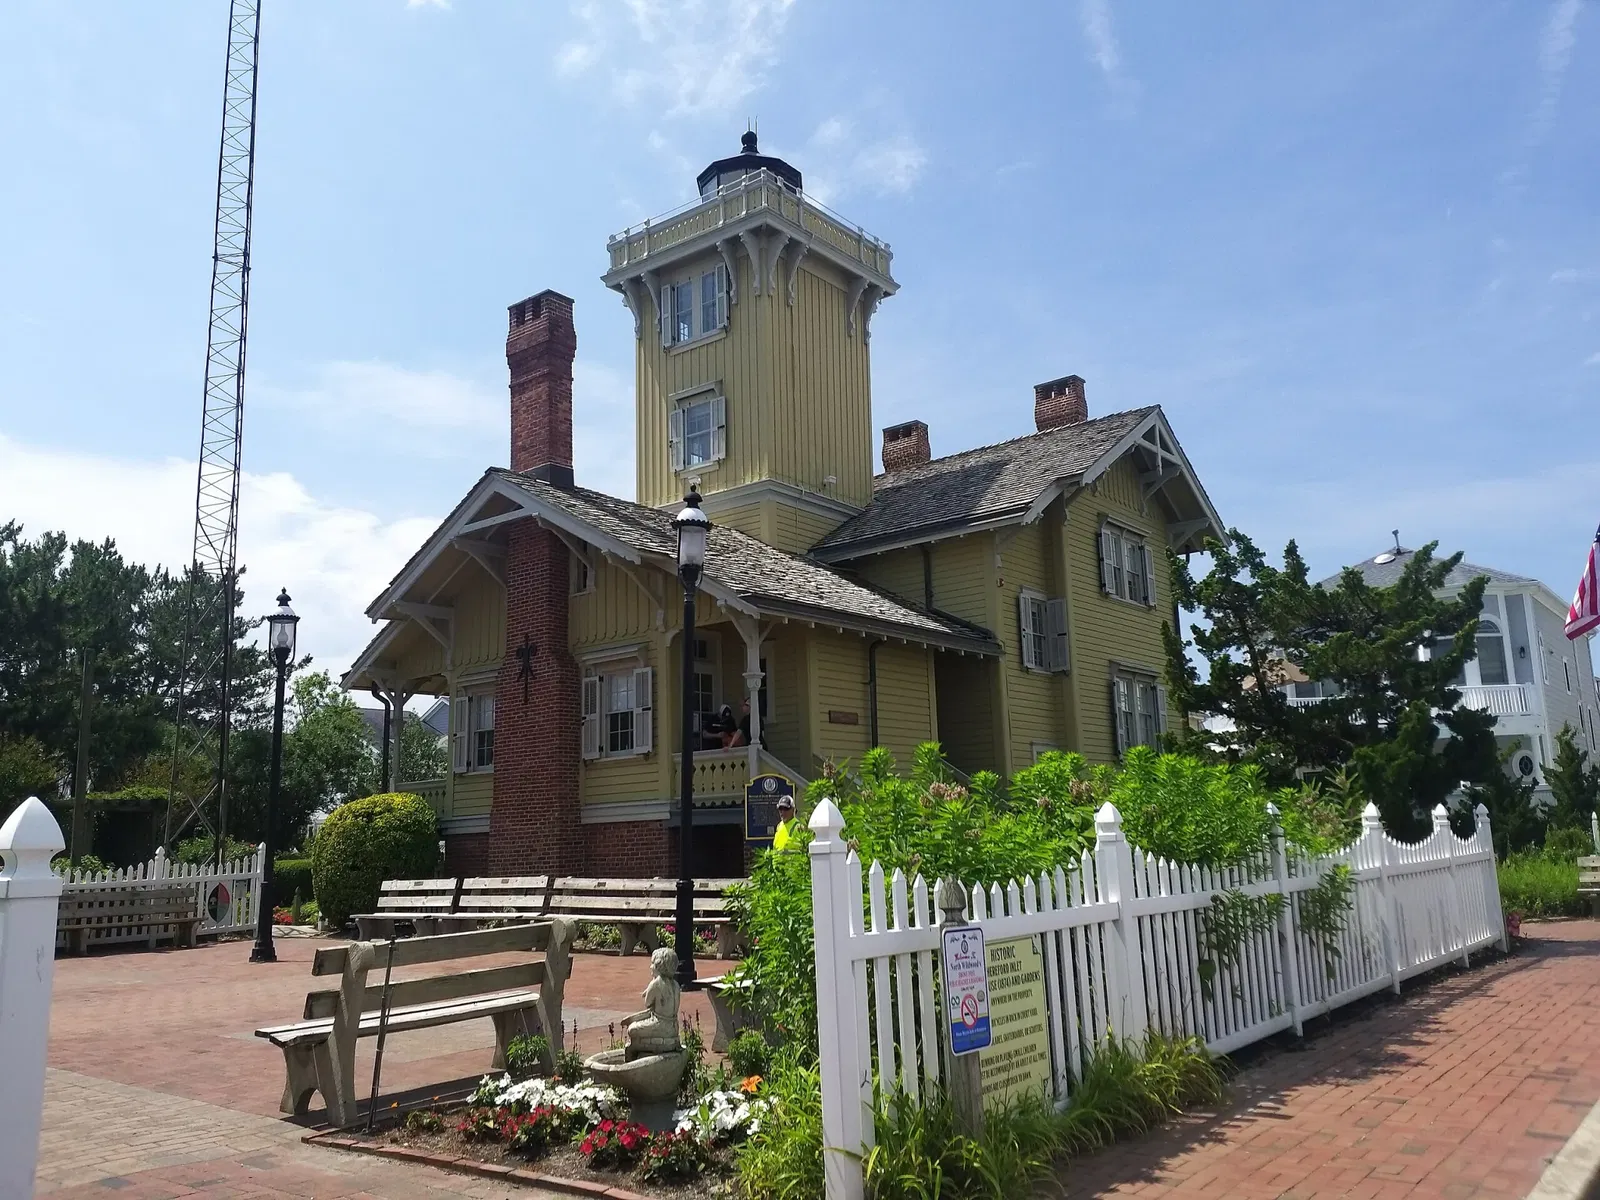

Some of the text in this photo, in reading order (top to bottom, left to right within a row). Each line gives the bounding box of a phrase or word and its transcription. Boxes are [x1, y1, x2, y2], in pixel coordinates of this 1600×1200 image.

[990, 945, 1016, 962] HISTORIC
[1010, 960, 1022, 972] INLET
[1012, 974, 1020, 986] AND
[1021, 970, 1040, 984] GARDENS
